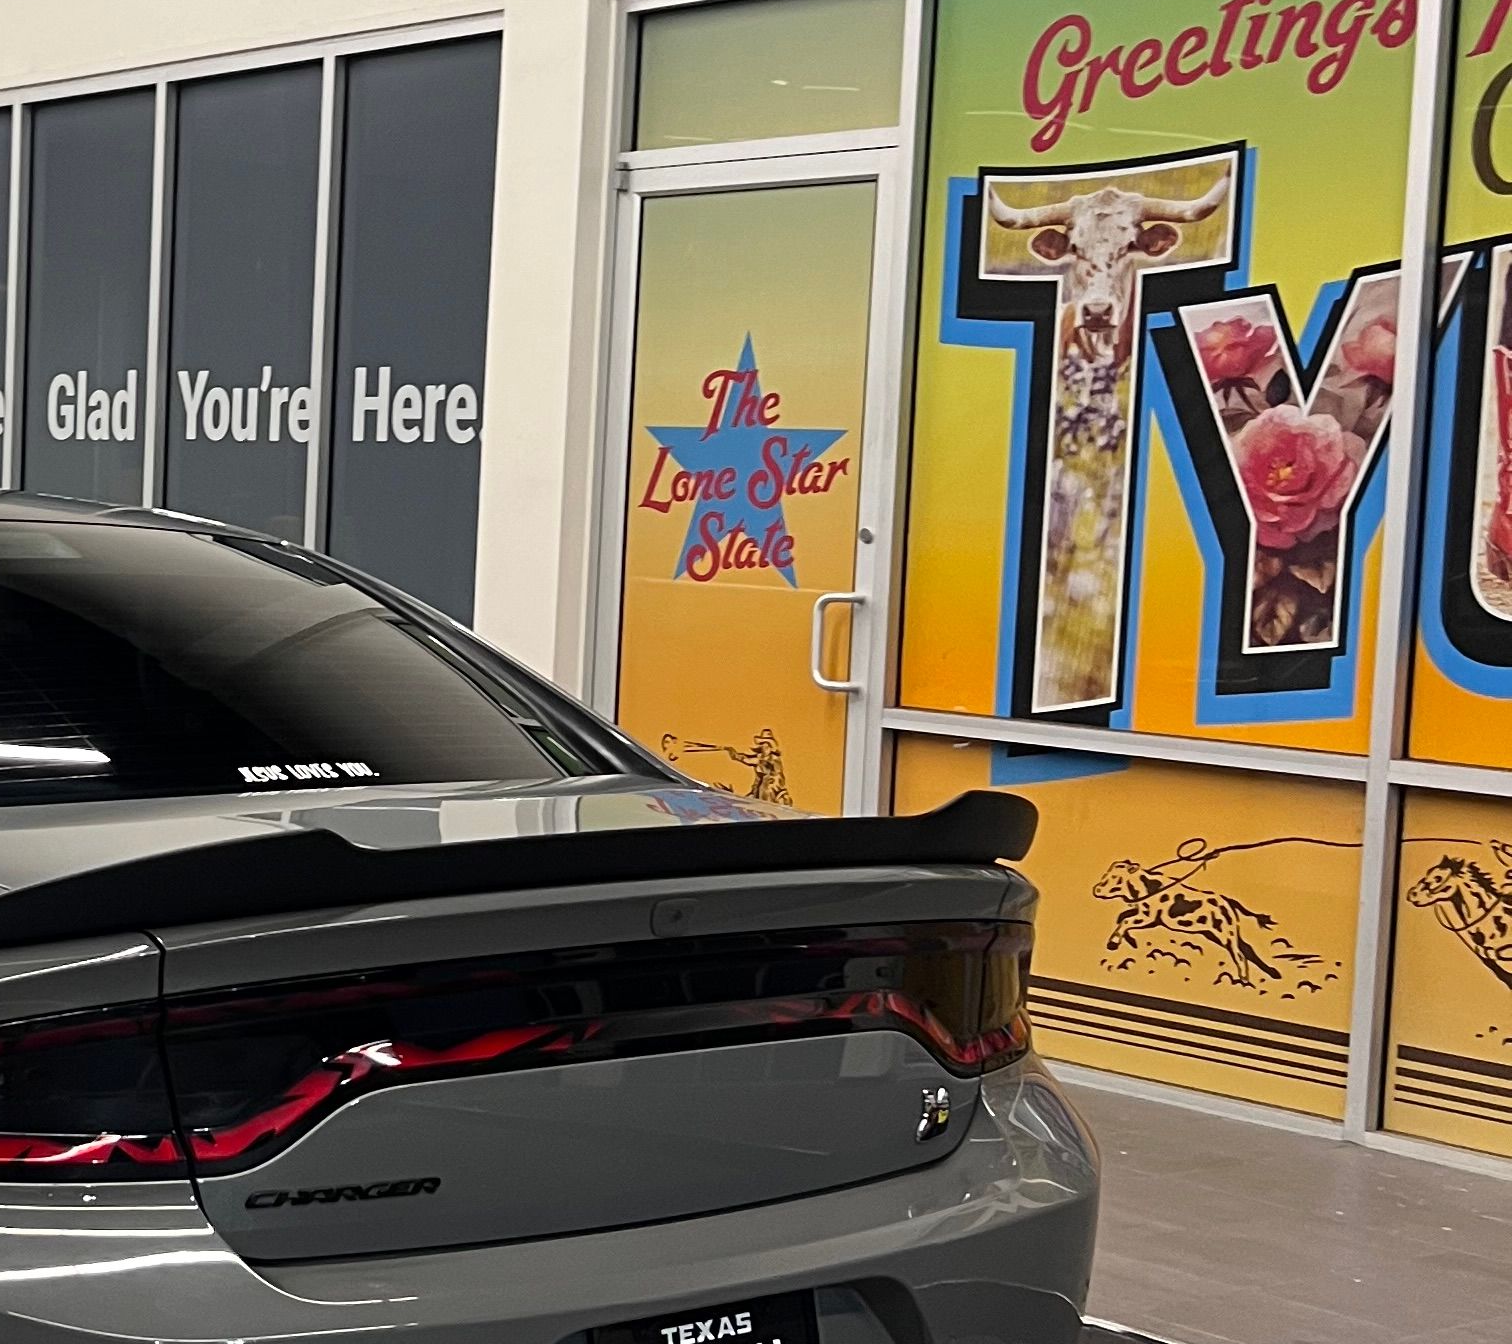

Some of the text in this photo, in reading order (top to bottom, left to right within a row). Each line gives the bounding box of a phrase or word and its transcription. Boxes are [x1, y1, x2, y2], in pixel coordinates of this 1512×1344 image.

[47, 369, 138, 442] Glad
[177, 366, 312, 444] You're
[702, 368, 781, 442] The
[638, 436, 849, 514] Lone Star
[685, 511, 795, 582] State
[244, 1177, 442, 1209] CHARGER
